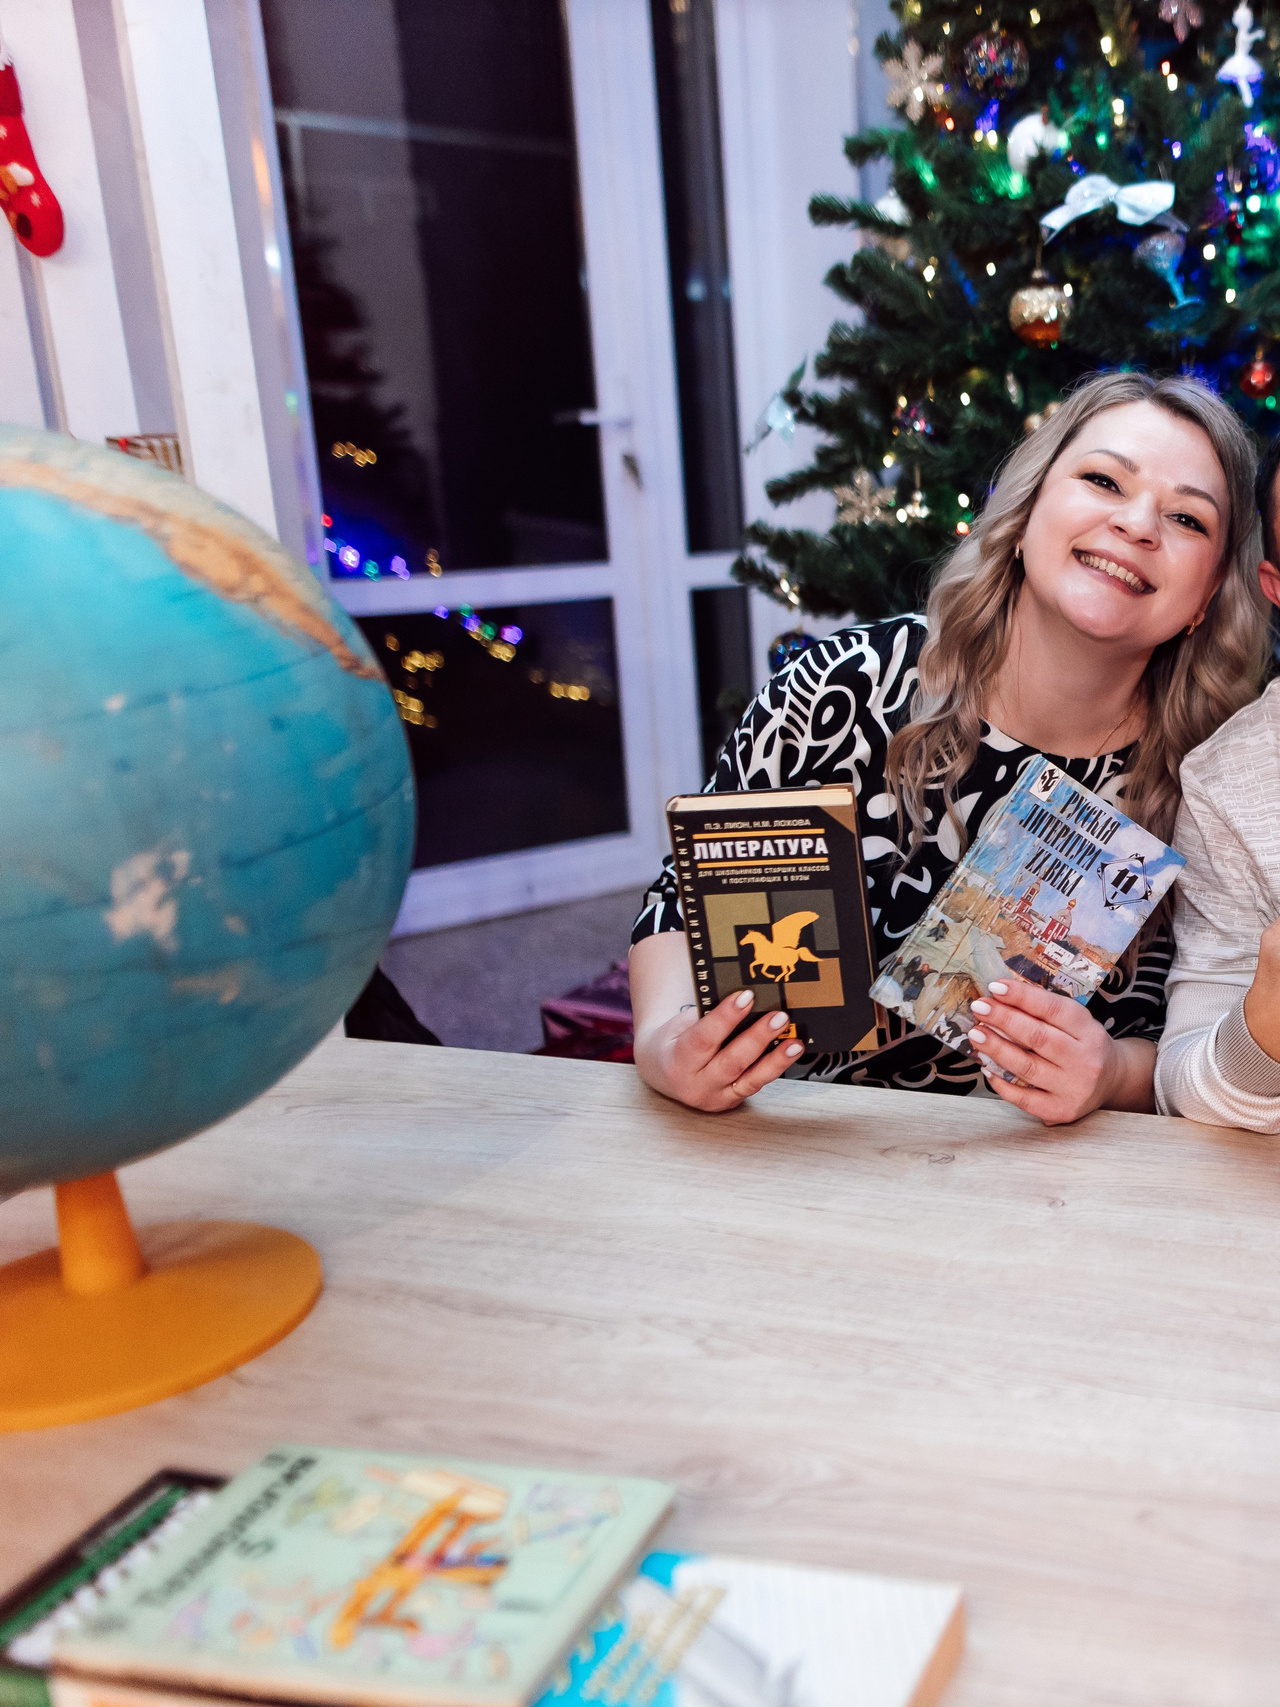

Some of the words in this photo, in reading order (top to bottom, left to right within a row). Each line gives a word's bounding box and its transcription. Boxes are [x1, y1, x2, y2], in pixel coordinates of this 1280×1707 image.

[1019, 803, 1102, 871] ЛИТЕРАТУРА
[1060, 790, 1121, 845] РУССКАЯ
[693, 837, 829, 860] ЛИТЕРАТУРА
[674, 825, 703, 950] АБИТУРИЕНТУ
[1042, 858, 1083, 897] ВЕКА
[1110, 868, 1139, 895] 11
[696, 959, 712, 1015] МОЩЬ
